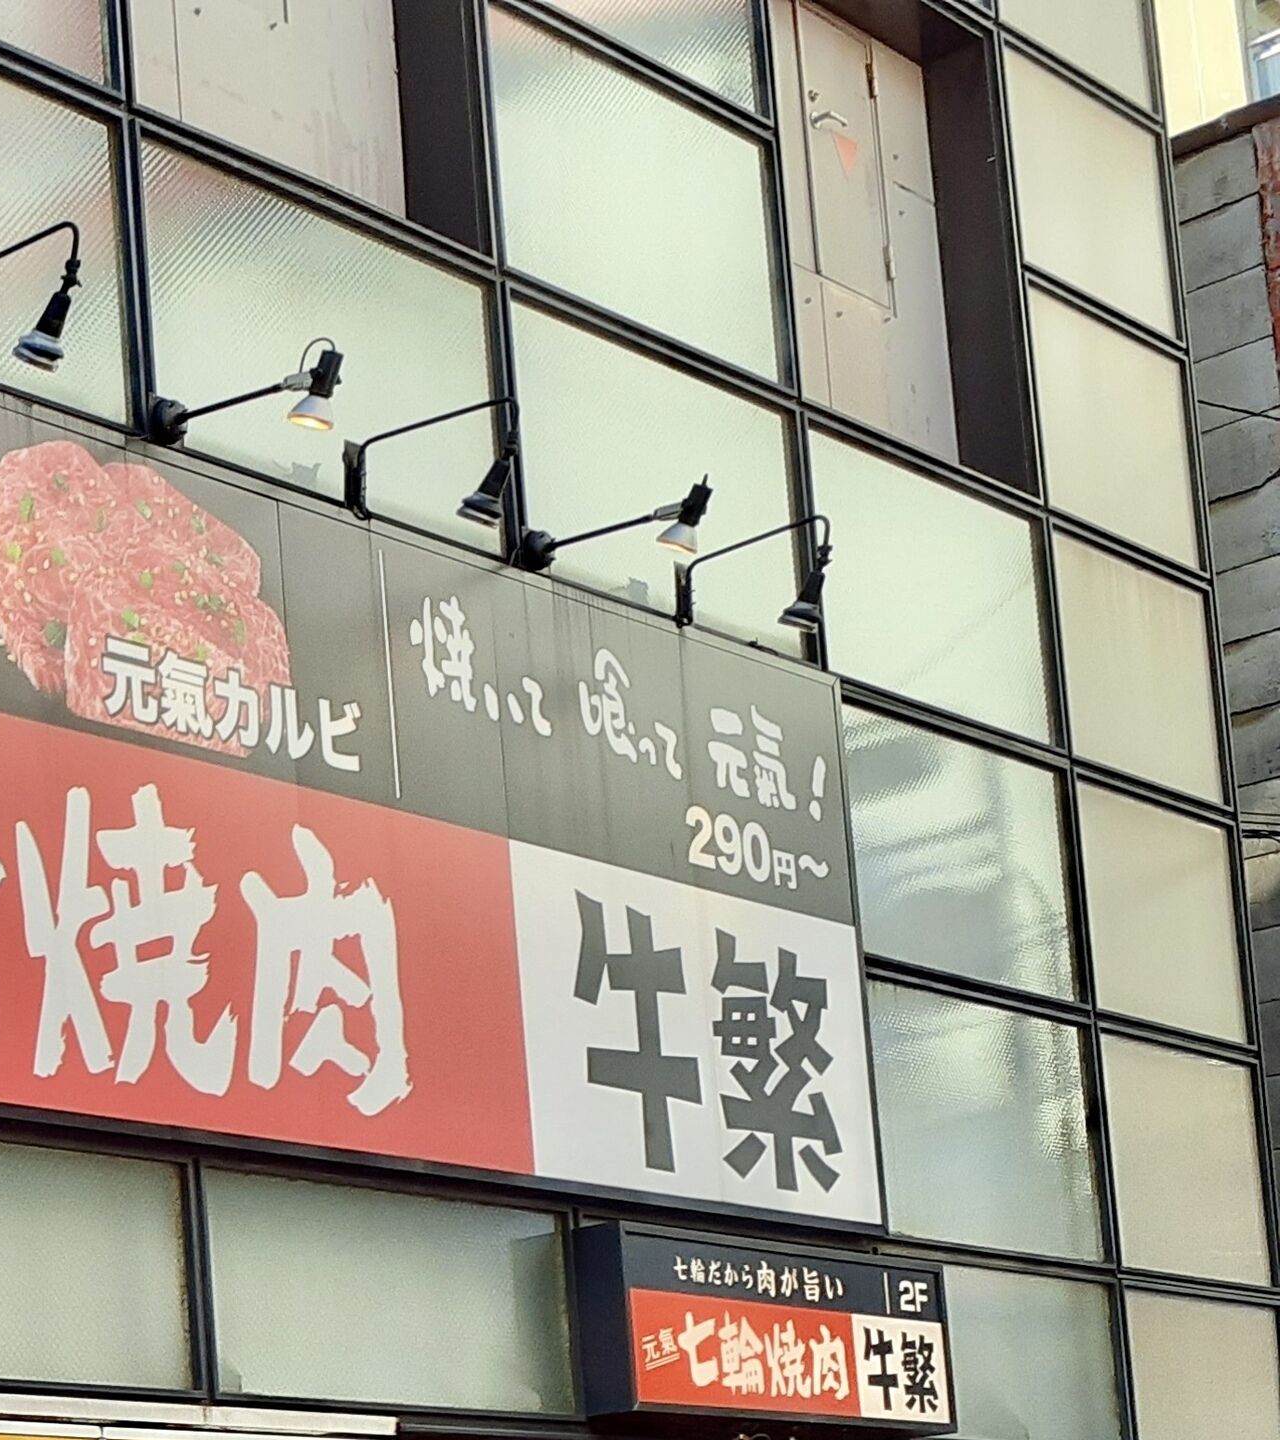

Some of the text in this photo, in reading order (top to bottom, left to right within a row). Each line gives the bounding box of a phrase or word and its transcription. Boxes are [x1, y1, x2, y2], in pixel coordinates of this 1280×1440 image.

[101, 632, 363, 773] 元氣カルビ
[573, 888, 845, 1194] 牛繁
[673, 1255, 844, 1303] 七輪だから肉が旨い
[898, 1279, 929, 1313] 2F
[640, 1327, 679, 1359] 元氣
[677, 1310, 851, 1401] 七輪焼肉
[862, 1325, 939, 1414] 牛繁
